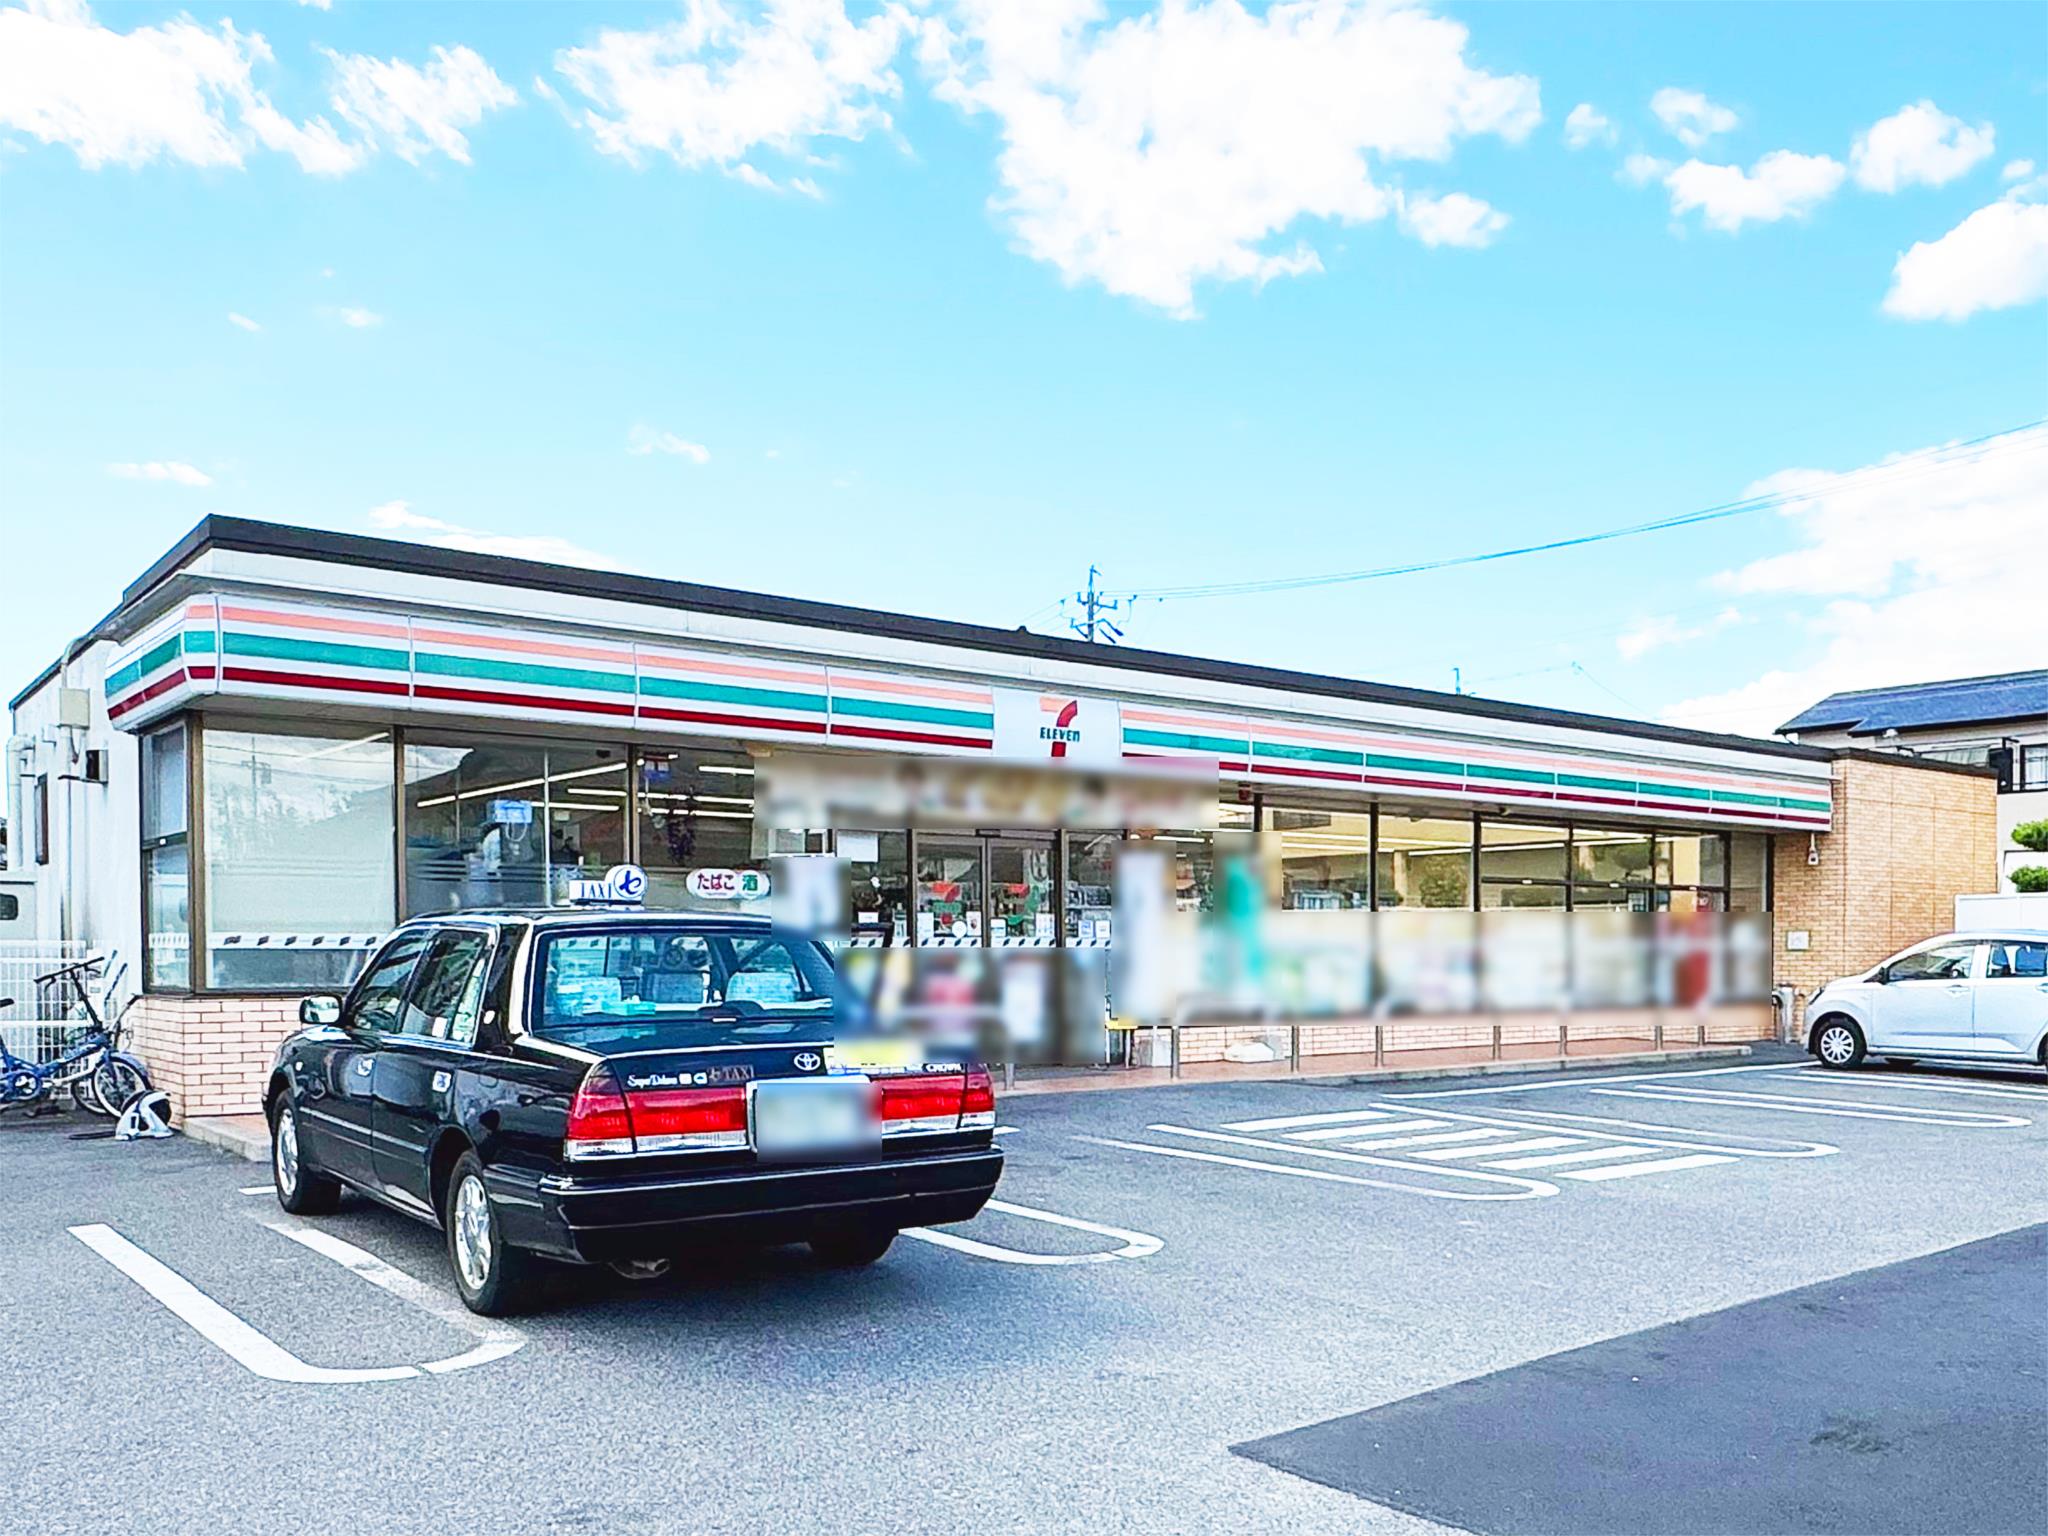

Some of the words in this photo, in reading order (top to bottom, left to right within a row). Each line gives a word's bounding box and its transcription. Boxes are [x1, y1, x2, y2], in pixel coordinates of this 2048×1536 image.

[697, 873, 735, 890] たばこ
[742, 875, 757, 891] 酒
[581, 882, 612, 899] TAXI
[723, 1065, 754, 1081] TAXI
